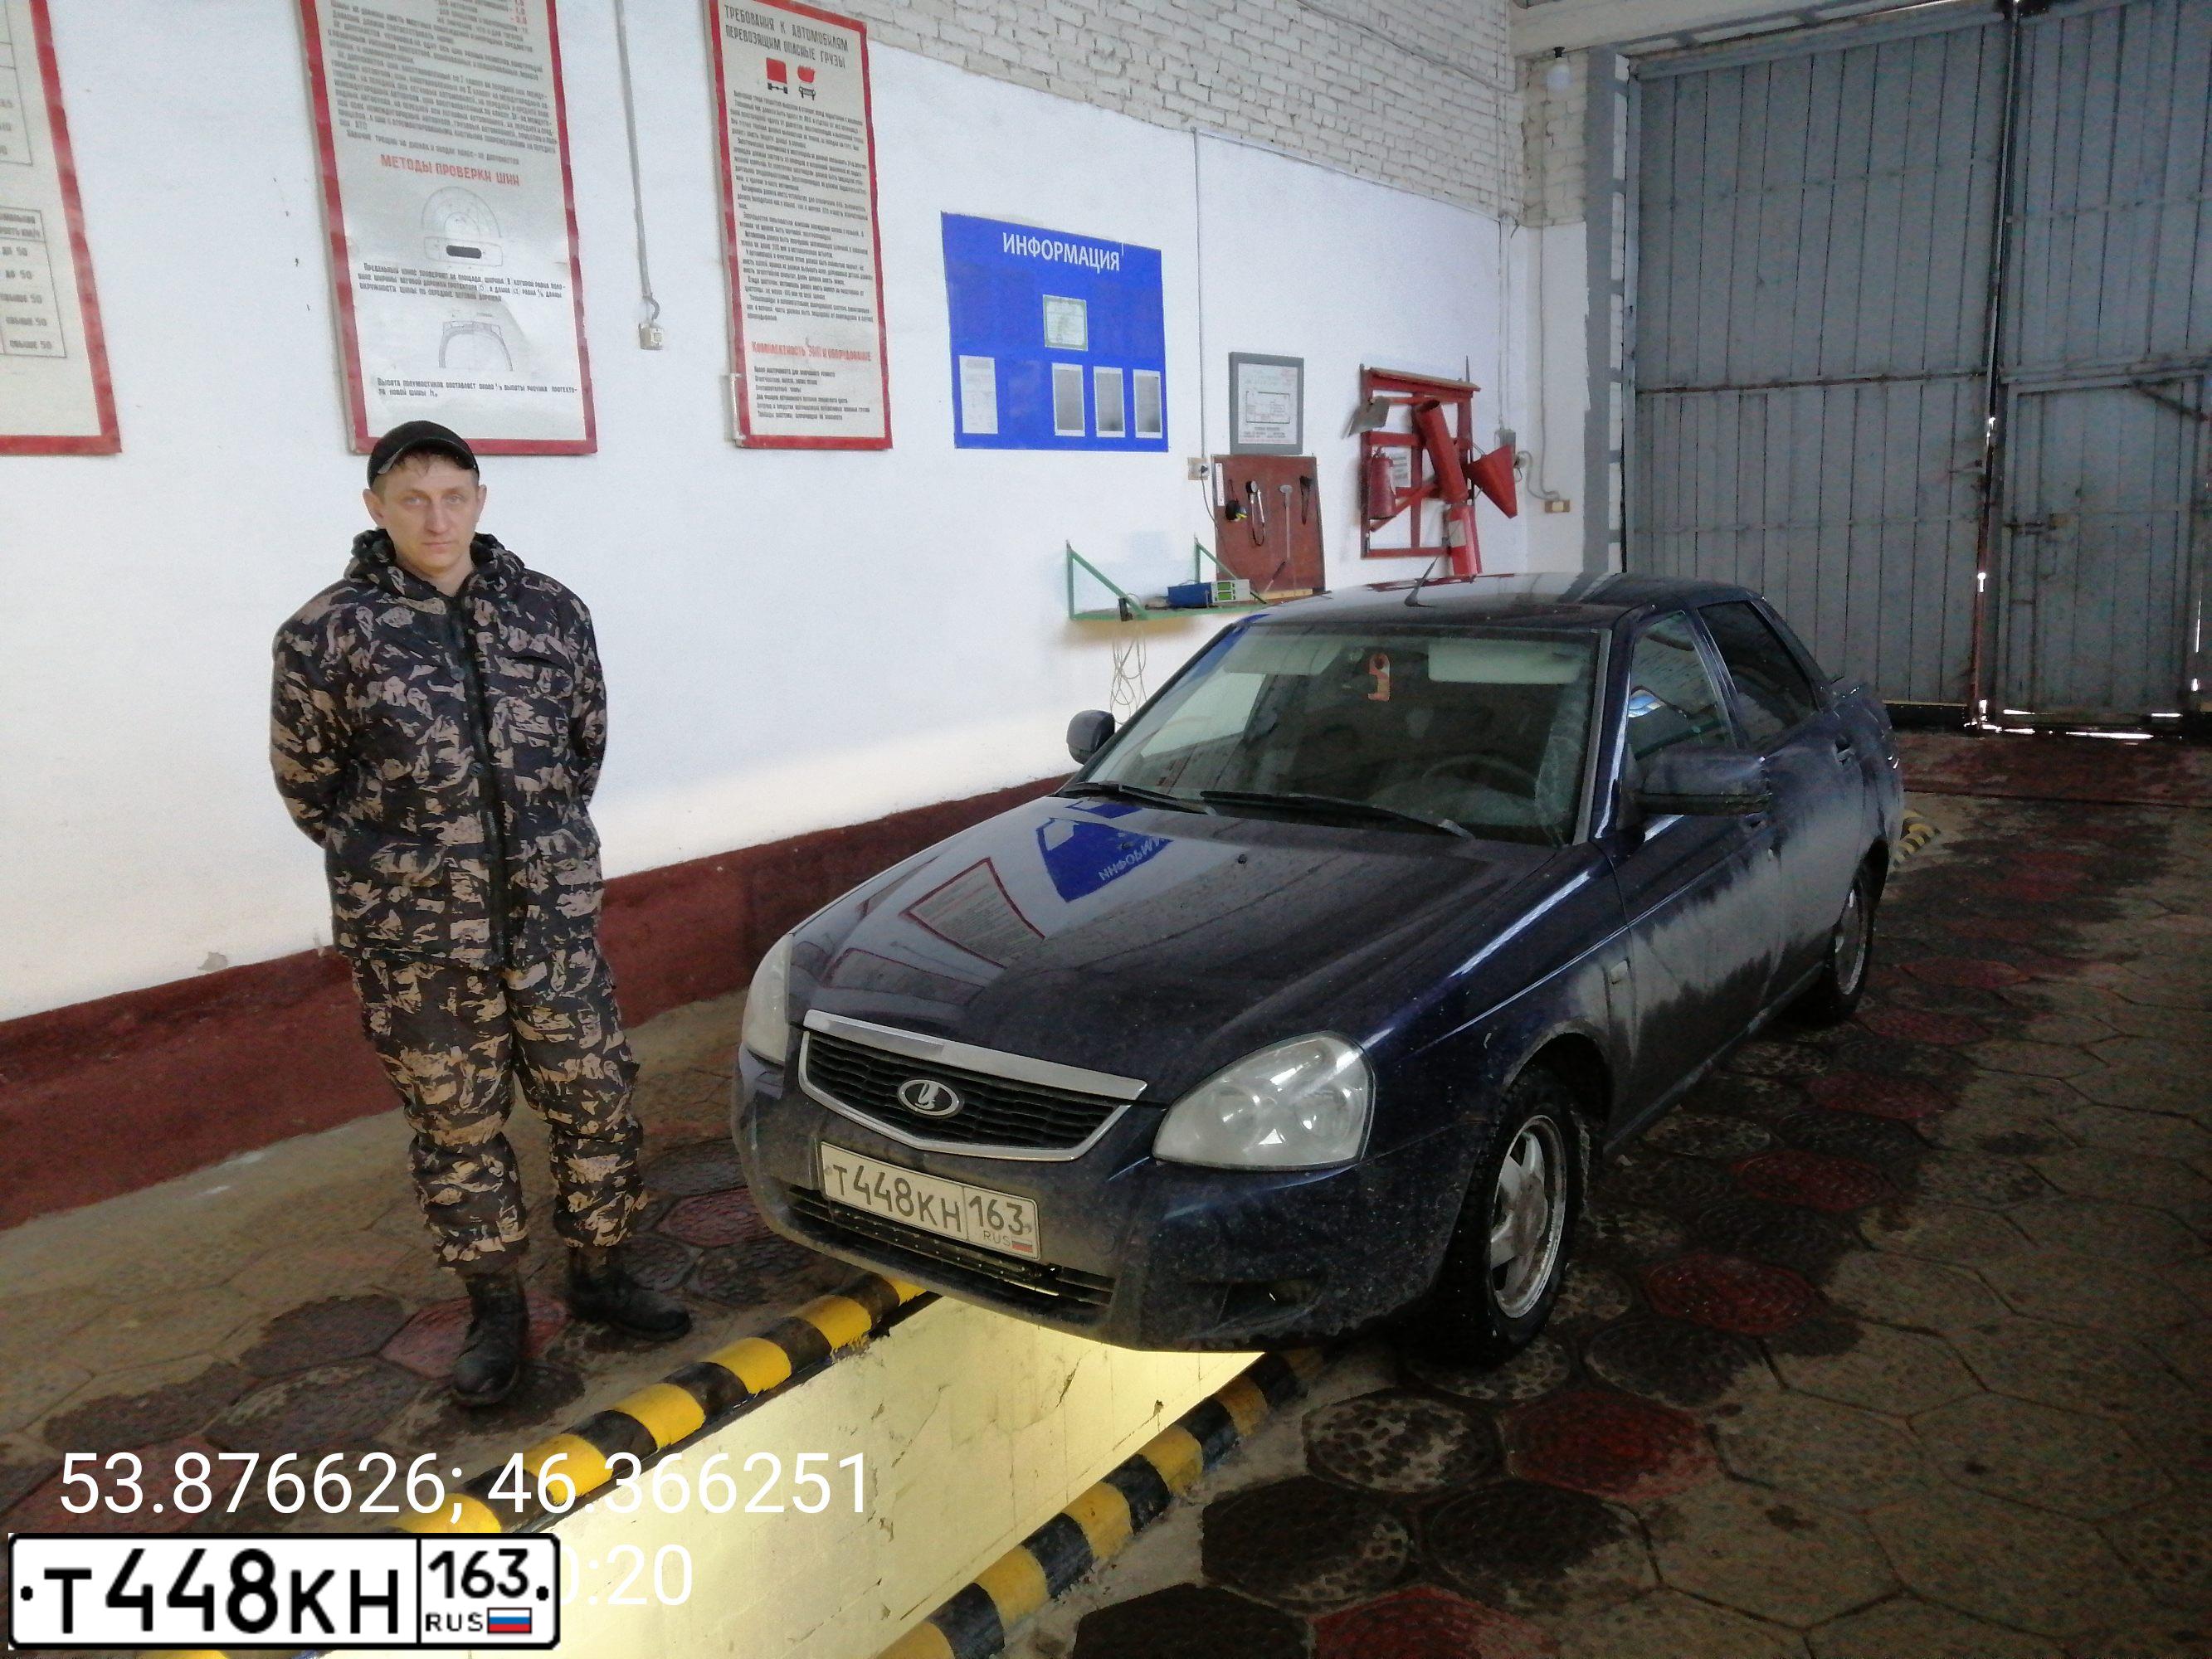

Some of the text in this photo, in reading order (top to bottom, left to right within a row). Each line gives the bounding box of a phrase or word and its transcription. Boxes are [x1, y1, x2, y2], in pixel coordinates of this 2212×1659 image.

[724, 4, 848, 51] ТРЕБОВАНИЯ К АВТОМОБИЛЯМ
[725, 24, 845, 68] ПЕРЕВОЗЯЩИМ ОПАСНЫЕ ГРУЗЫ
[380, 153, 519, 186] МЕТОДЫ ПРОВЕРКИ ШИН
[1003, 232, 1120, 274] ИНФОРМАЦИЯ
[833, 1164, 1024, 1236] Т448КН 163
[983, 1230, 1011, 1246] RUS
